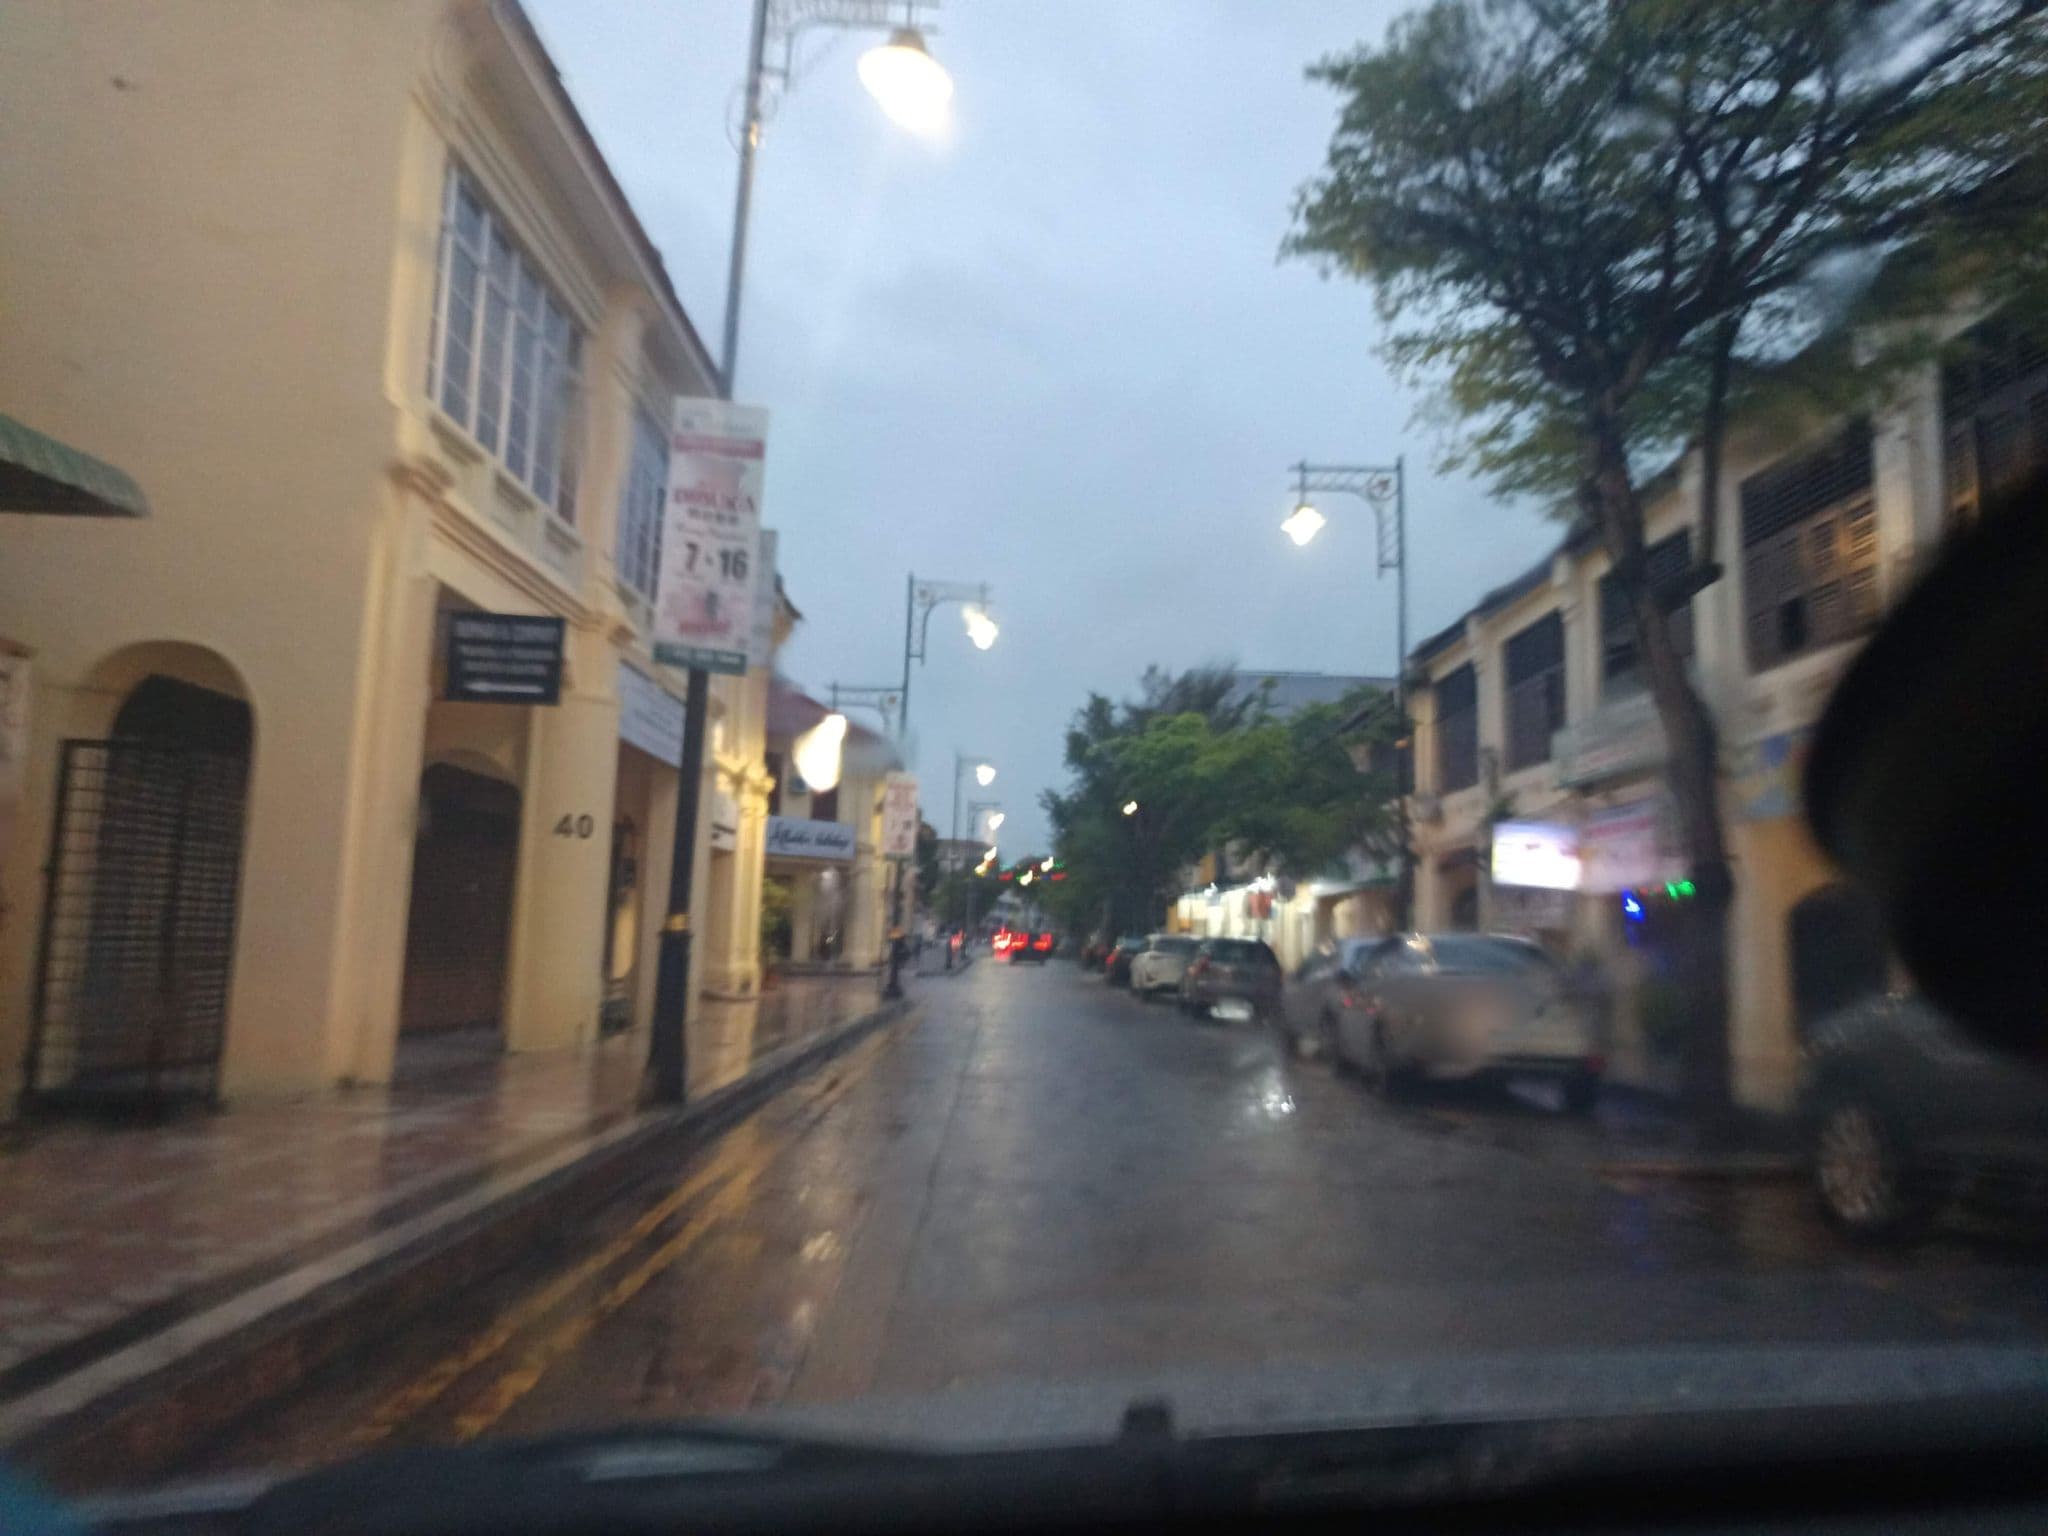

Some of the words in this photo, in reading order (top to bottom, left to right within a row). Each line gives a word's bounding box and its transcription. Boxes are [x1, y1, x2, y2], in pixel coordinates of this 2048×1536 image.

[685, 542, 699, 573] 7
[719, 550, 749, 581] 16
[552, 813, 594, 839] 40
